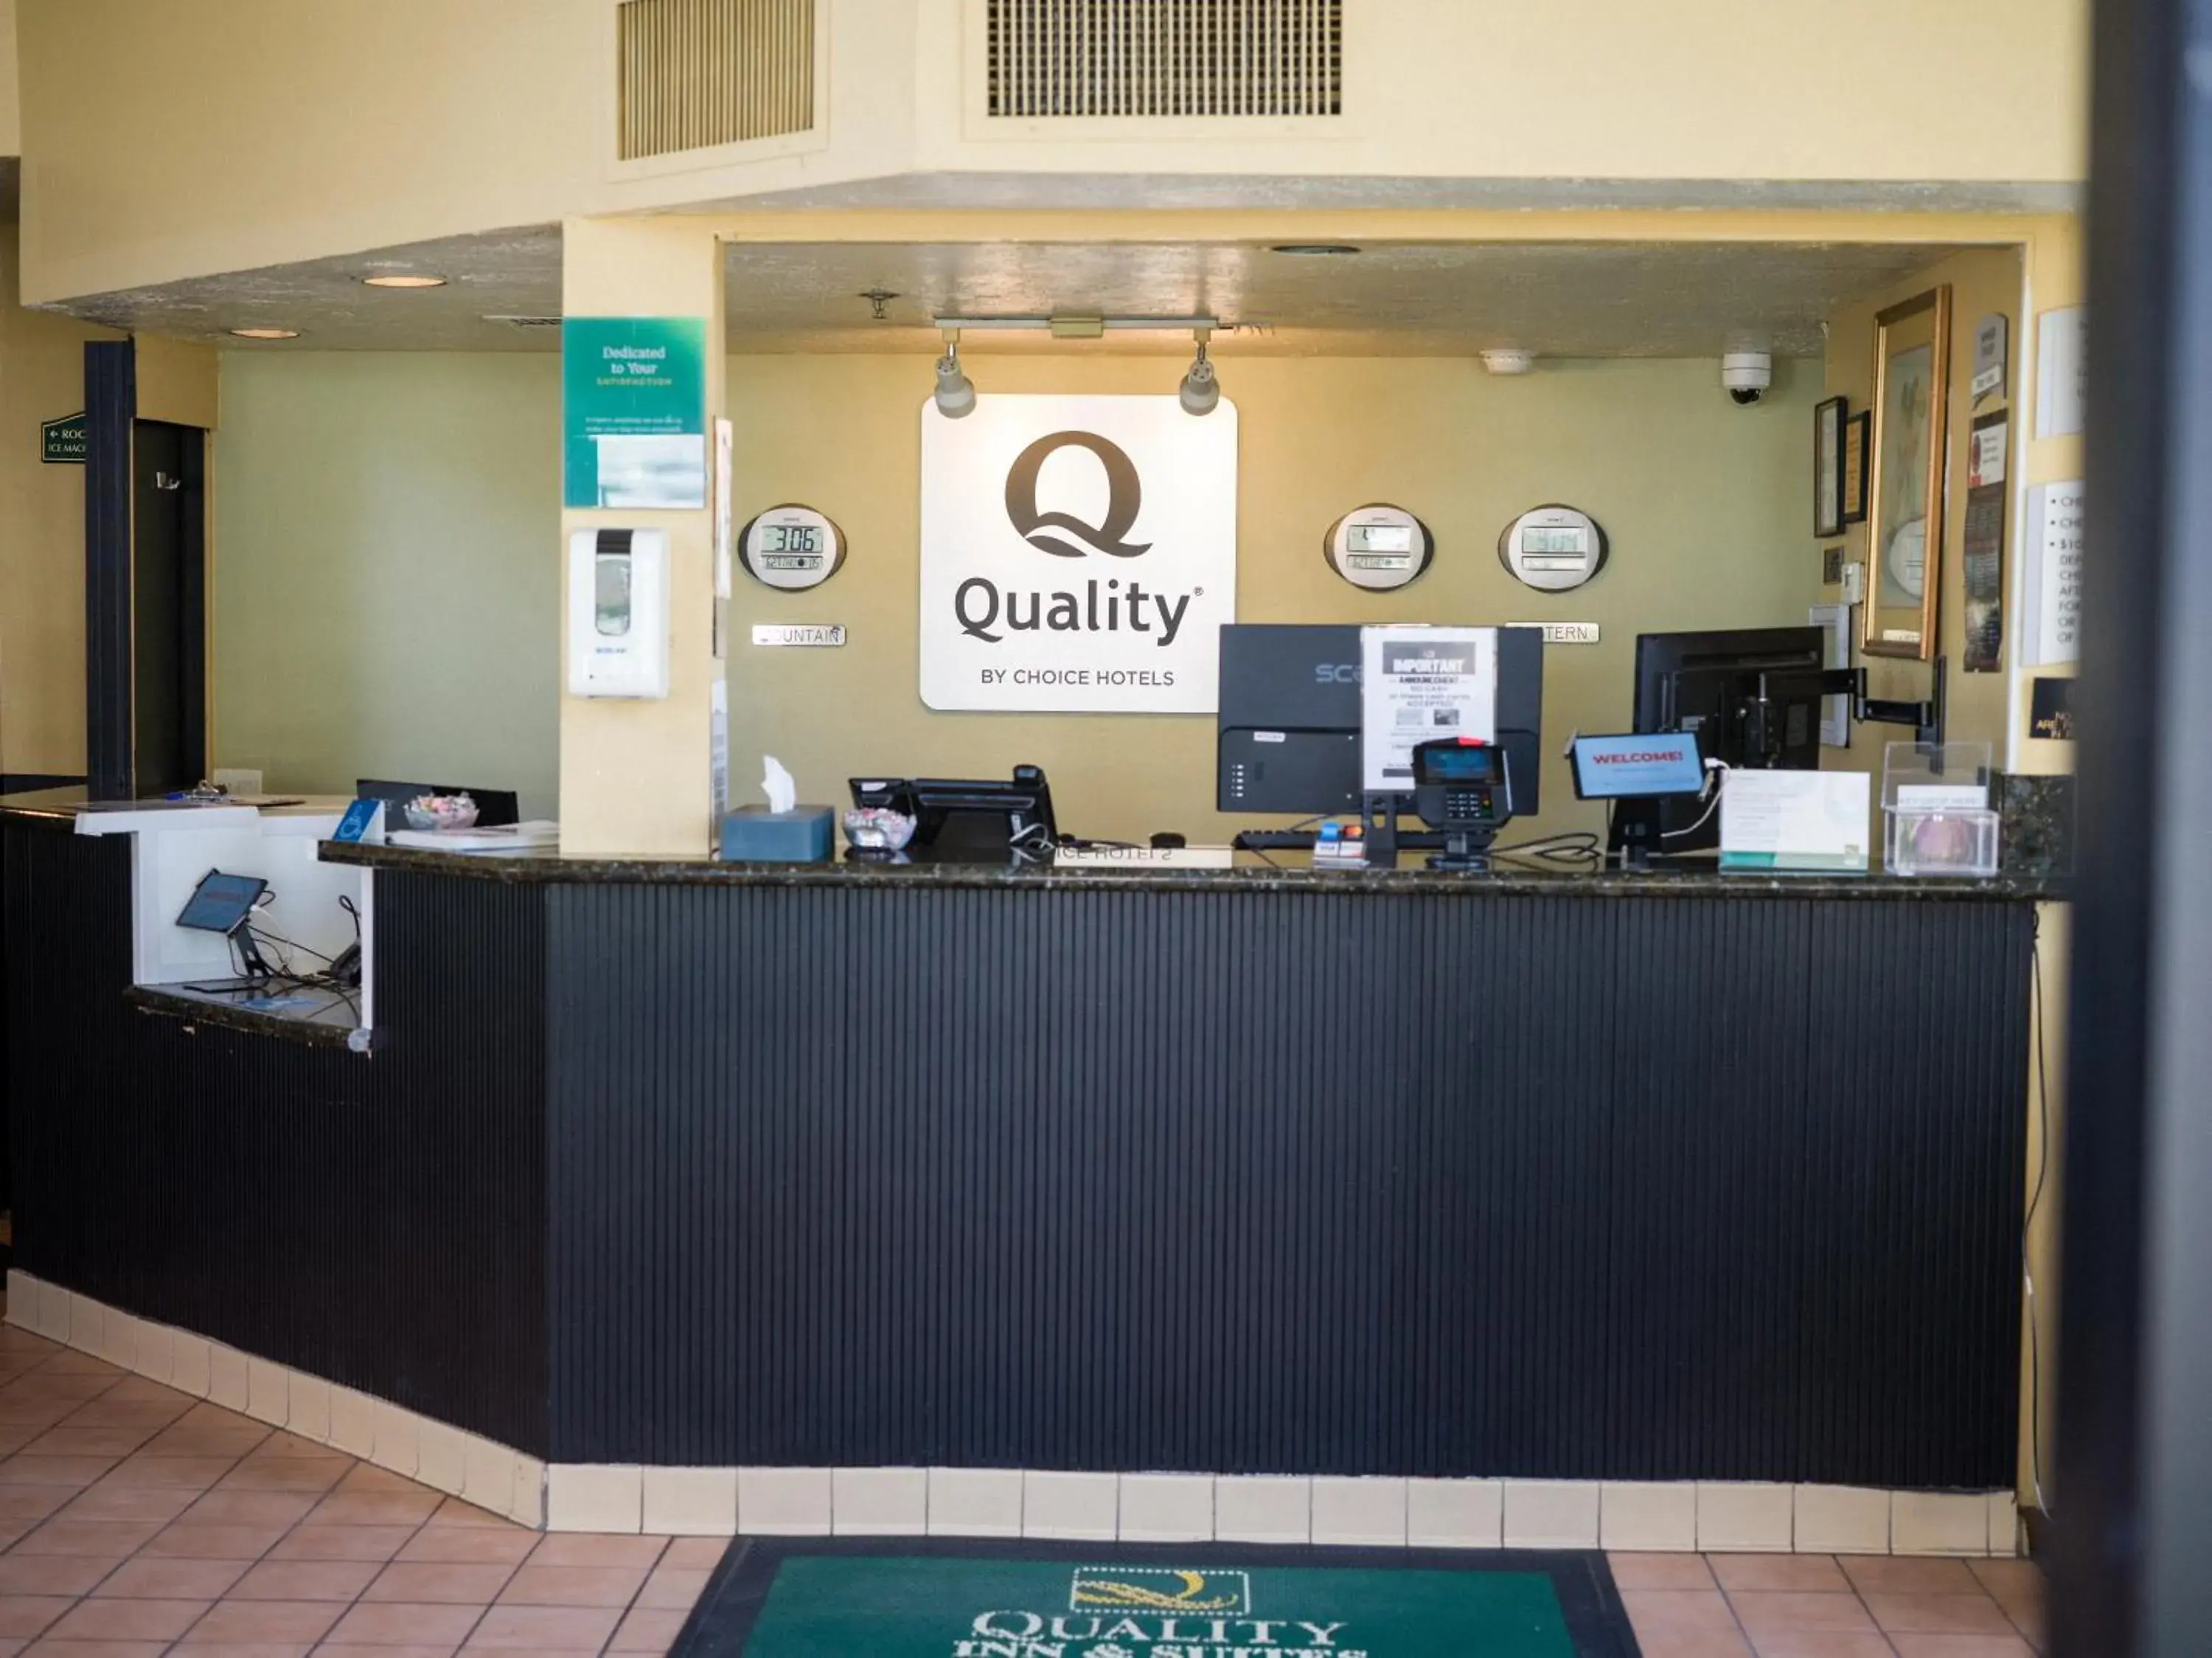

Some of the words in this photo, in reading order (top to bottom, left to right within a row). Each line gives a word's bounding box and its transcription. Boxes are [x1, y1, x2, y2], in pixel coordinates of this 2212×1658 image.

[602, 345, 666, 359] Dedicated
[611, 363, 625, 375] to
[627, 362, 658, 375] Your
[955, 577, 1191, 647] Quality
[1545, 626, 1587, 639] TERN
[1393, 659, 1465, 673] IMPORTANT
[981, 670, 1006, 684] BY
[1014, 670, 1090, 685] CHOICE
[1097, 670, 1174, 686] HOTELS
[1593, 750, 1683, 765] WELCOME!
[973, 1609, 1349, 1646] QUALITY
